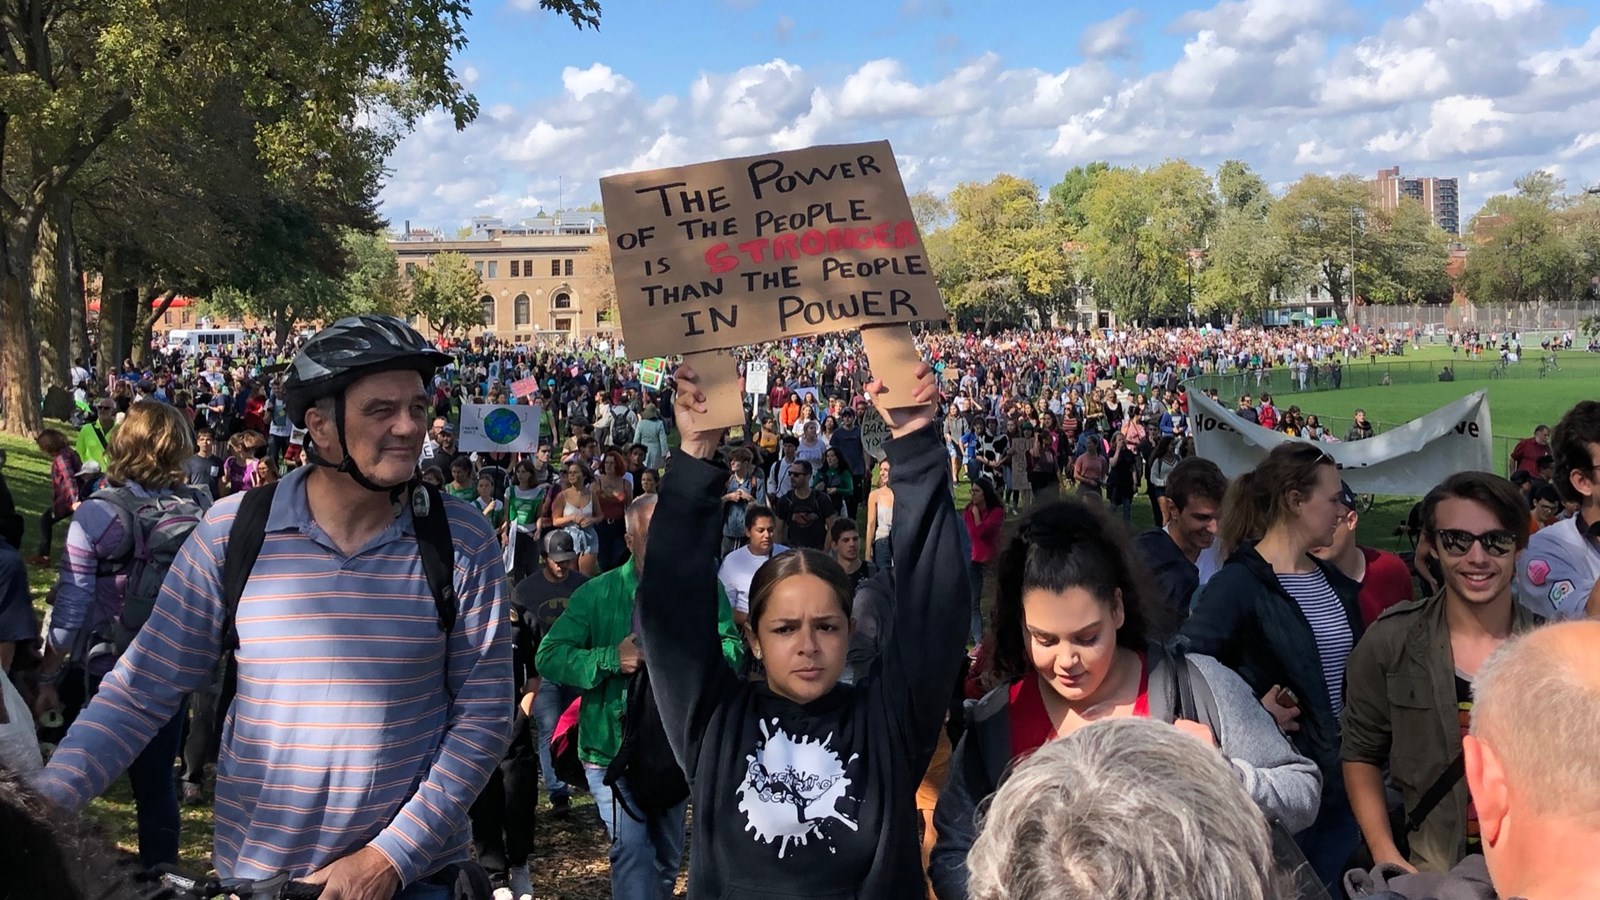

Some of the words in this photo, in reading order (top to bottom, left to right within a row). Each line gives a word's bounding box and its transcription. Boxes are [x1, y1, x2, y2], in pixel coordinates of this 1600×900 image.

[635, 182, 732, 217] THE
[748, 155, 881, 199] POWER
[616, 226, 655, 250] OF
[677, 217, 738, 240] THE
[755, 200, 872, 237] PEOPLE
[644, 257, 671, 276] IS
[704, 220, 918, 274] STRONGER
[641, 277, 724, 306] THAN
[740, 266, 801, 292] THE
[822, 254, 928, 281] PEOPLE
[681, 304, 738, 337] IN
[778, 289, 919, 332] POWER
